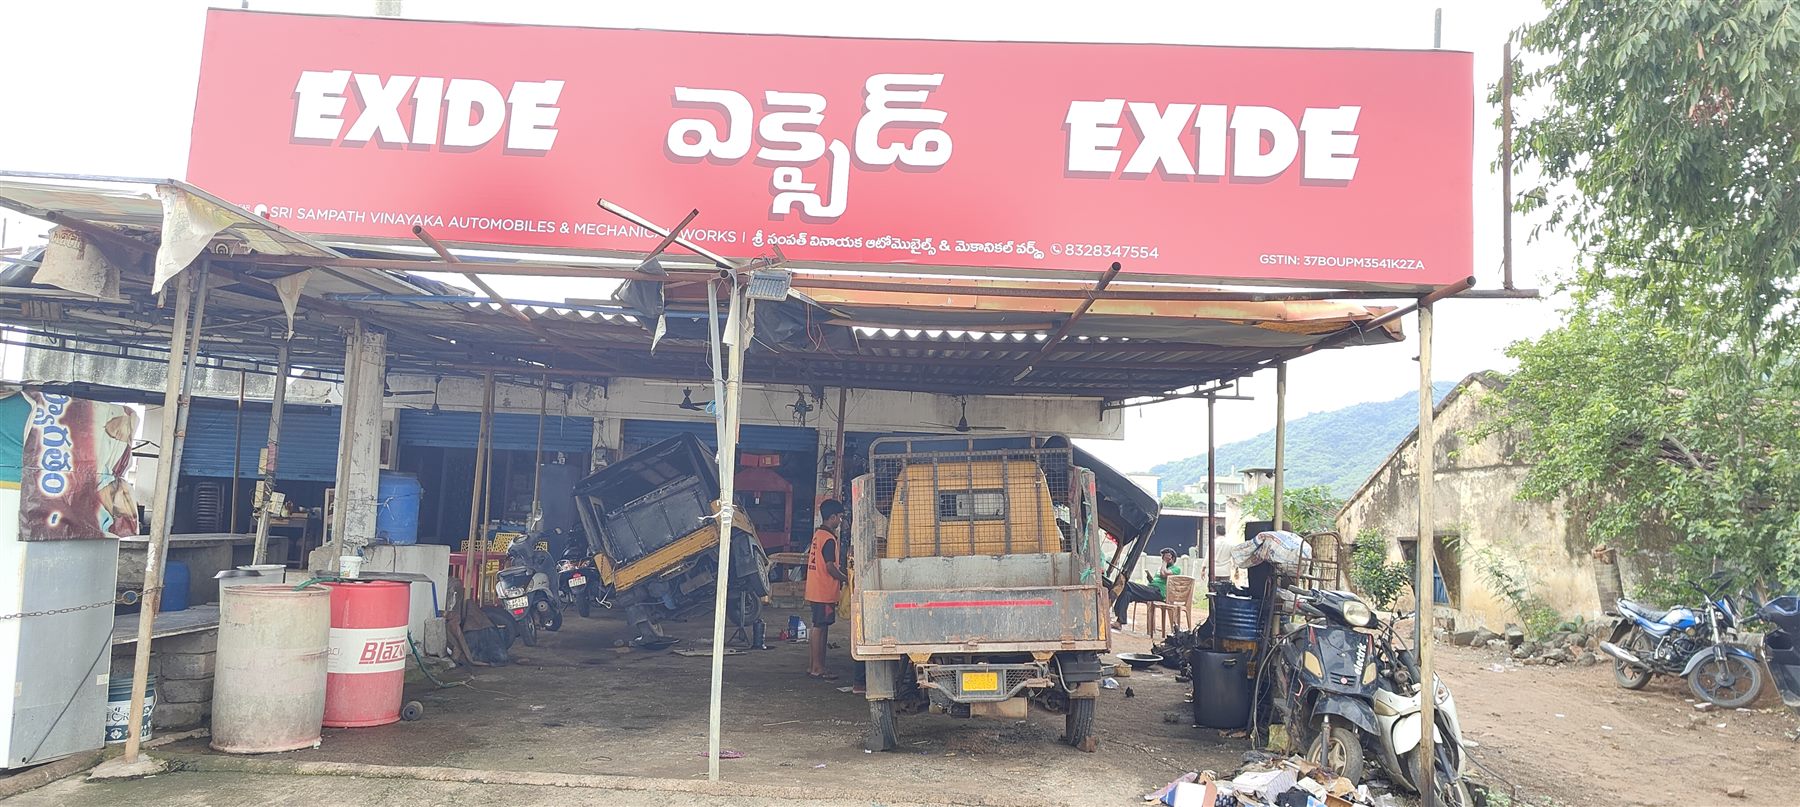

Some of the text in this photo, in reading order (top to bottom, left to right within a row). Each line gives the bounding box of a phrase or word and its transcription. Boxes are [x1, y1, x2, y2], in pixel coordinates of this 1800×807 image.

[291, 69, 566, 157] EXIDE
[666, 73, 953, 219] ఎక్సైడ్
[1064, 98, 1362, 184] EXIDE
[270, 206, 293, 219] SRI
[297, 208, 366, 224] SAMPATH
[370, 211, 444, 228] VINAYAKA
[448, 216, 556, 234] AUTOMOBILES
[559, 222, 570, 234] &
[680, 228, 737, 244] WORKS
[751, 229, 764, 247] శ్రీ
[767, 232, 808, 246] సంపత్
[809, 236, 863, 248] వినాయక
[939, 239, 951, 252] &
[1065, 244, 1159, 260] 8328347554
[1259, 254, 1425, 270] GSTIN: 37BOUPM3541K2ZA
[1353, 642, 1367, 676] electric
